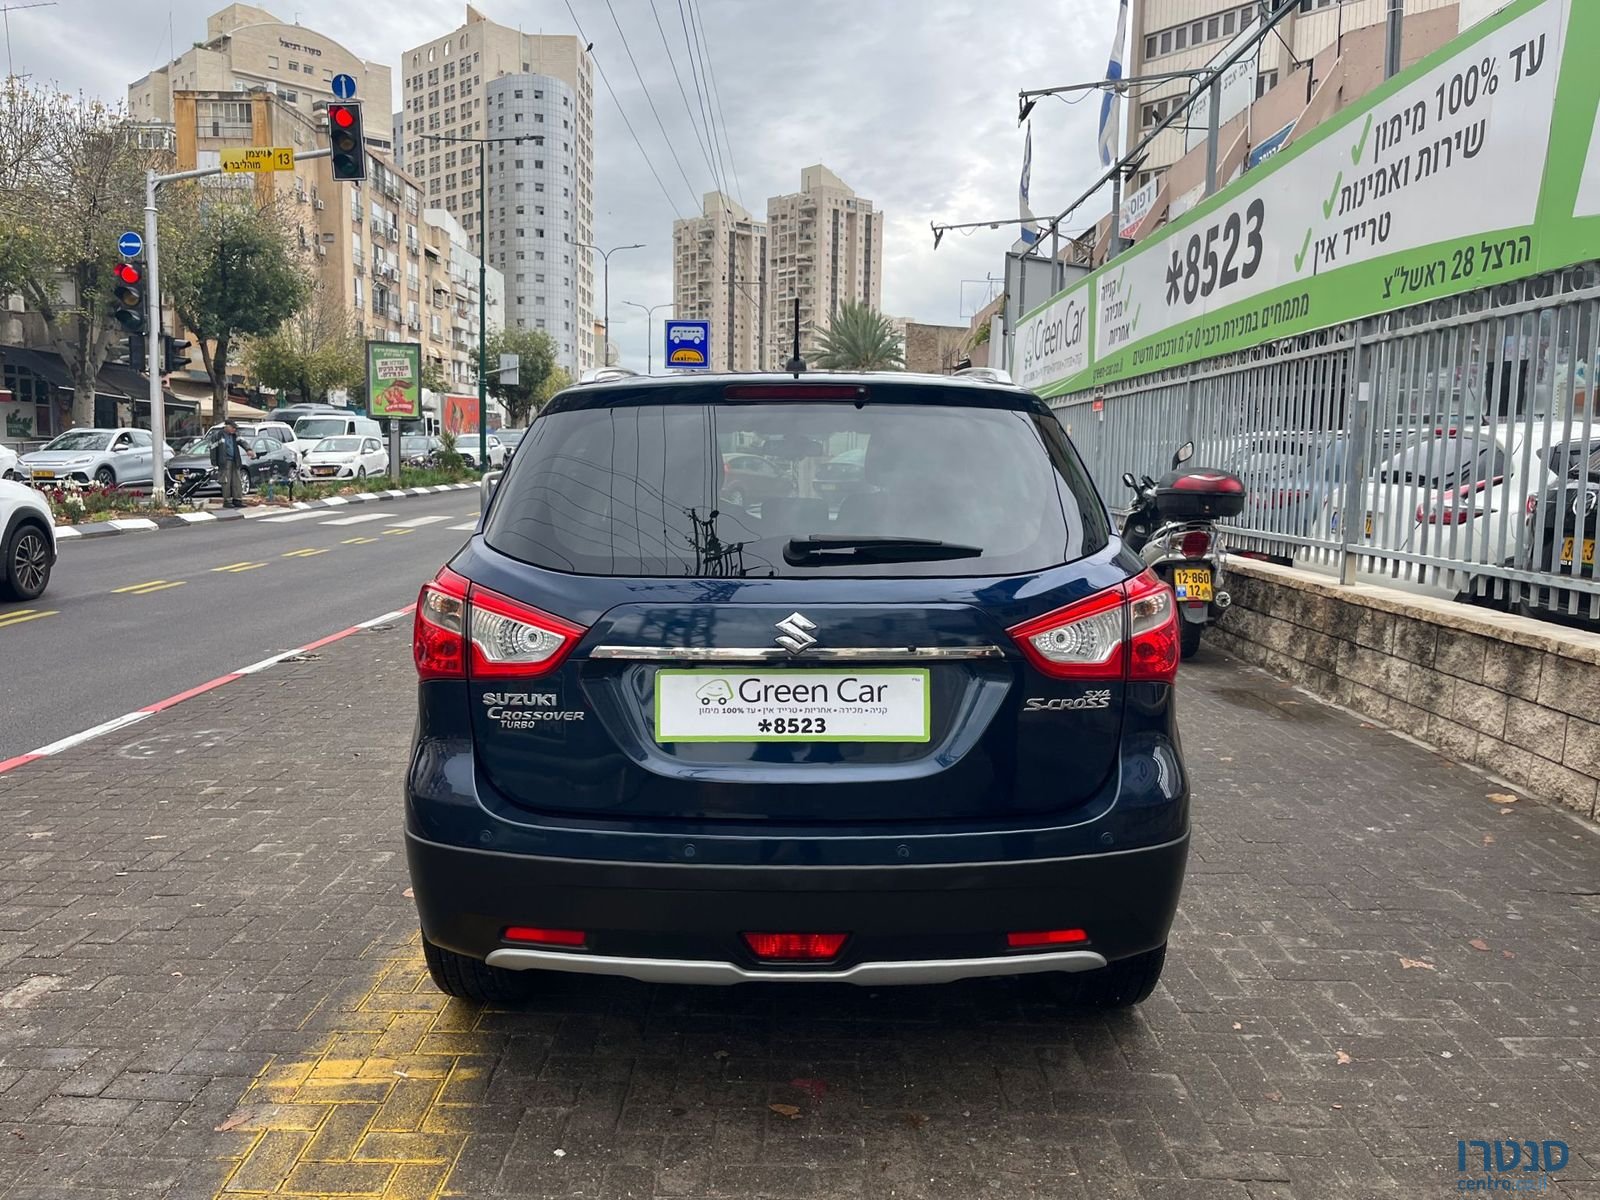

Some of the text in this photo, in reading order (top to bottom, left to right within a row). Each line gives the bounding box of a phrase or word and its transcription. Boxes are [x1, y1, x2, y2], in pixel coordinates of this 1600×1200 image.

[1373, 33, 1546, 164] עד 100% מימון
[245, 150, 267, 160] ויצמן
[278, 153, 290, 165] 13
[229, 159, 261, 169] מוהליבר
[1337, 118, 1486, 217] שירות ואמינות
[1313, 210, 1391, 276] טרייד אין
[1480, 235, 1532, 273] הרצל
[1450, 246, 1475, 281] 28
[1261, 293, 1310, 328] מתמחים
[1034, 300, 1086, 361] Green Car
[1221, 311, 1258, 341] במכירת
[1202, 324, 1221, 346] רכבי
[1189, 585, 1201, 596] 12
[739, 678, 888, 703] Green Car
[1083, 689, 1111, 699] SX4
[482, 693, 557, 706] SUZUKI
[487, 706, 585, 721] CROSSOVER
[699, 707, 720, 715] מימון
[762, 707, 775, 715] אין
[869, 707, 888, 715] קניה
[500, 720, 535, 729] TURBO
